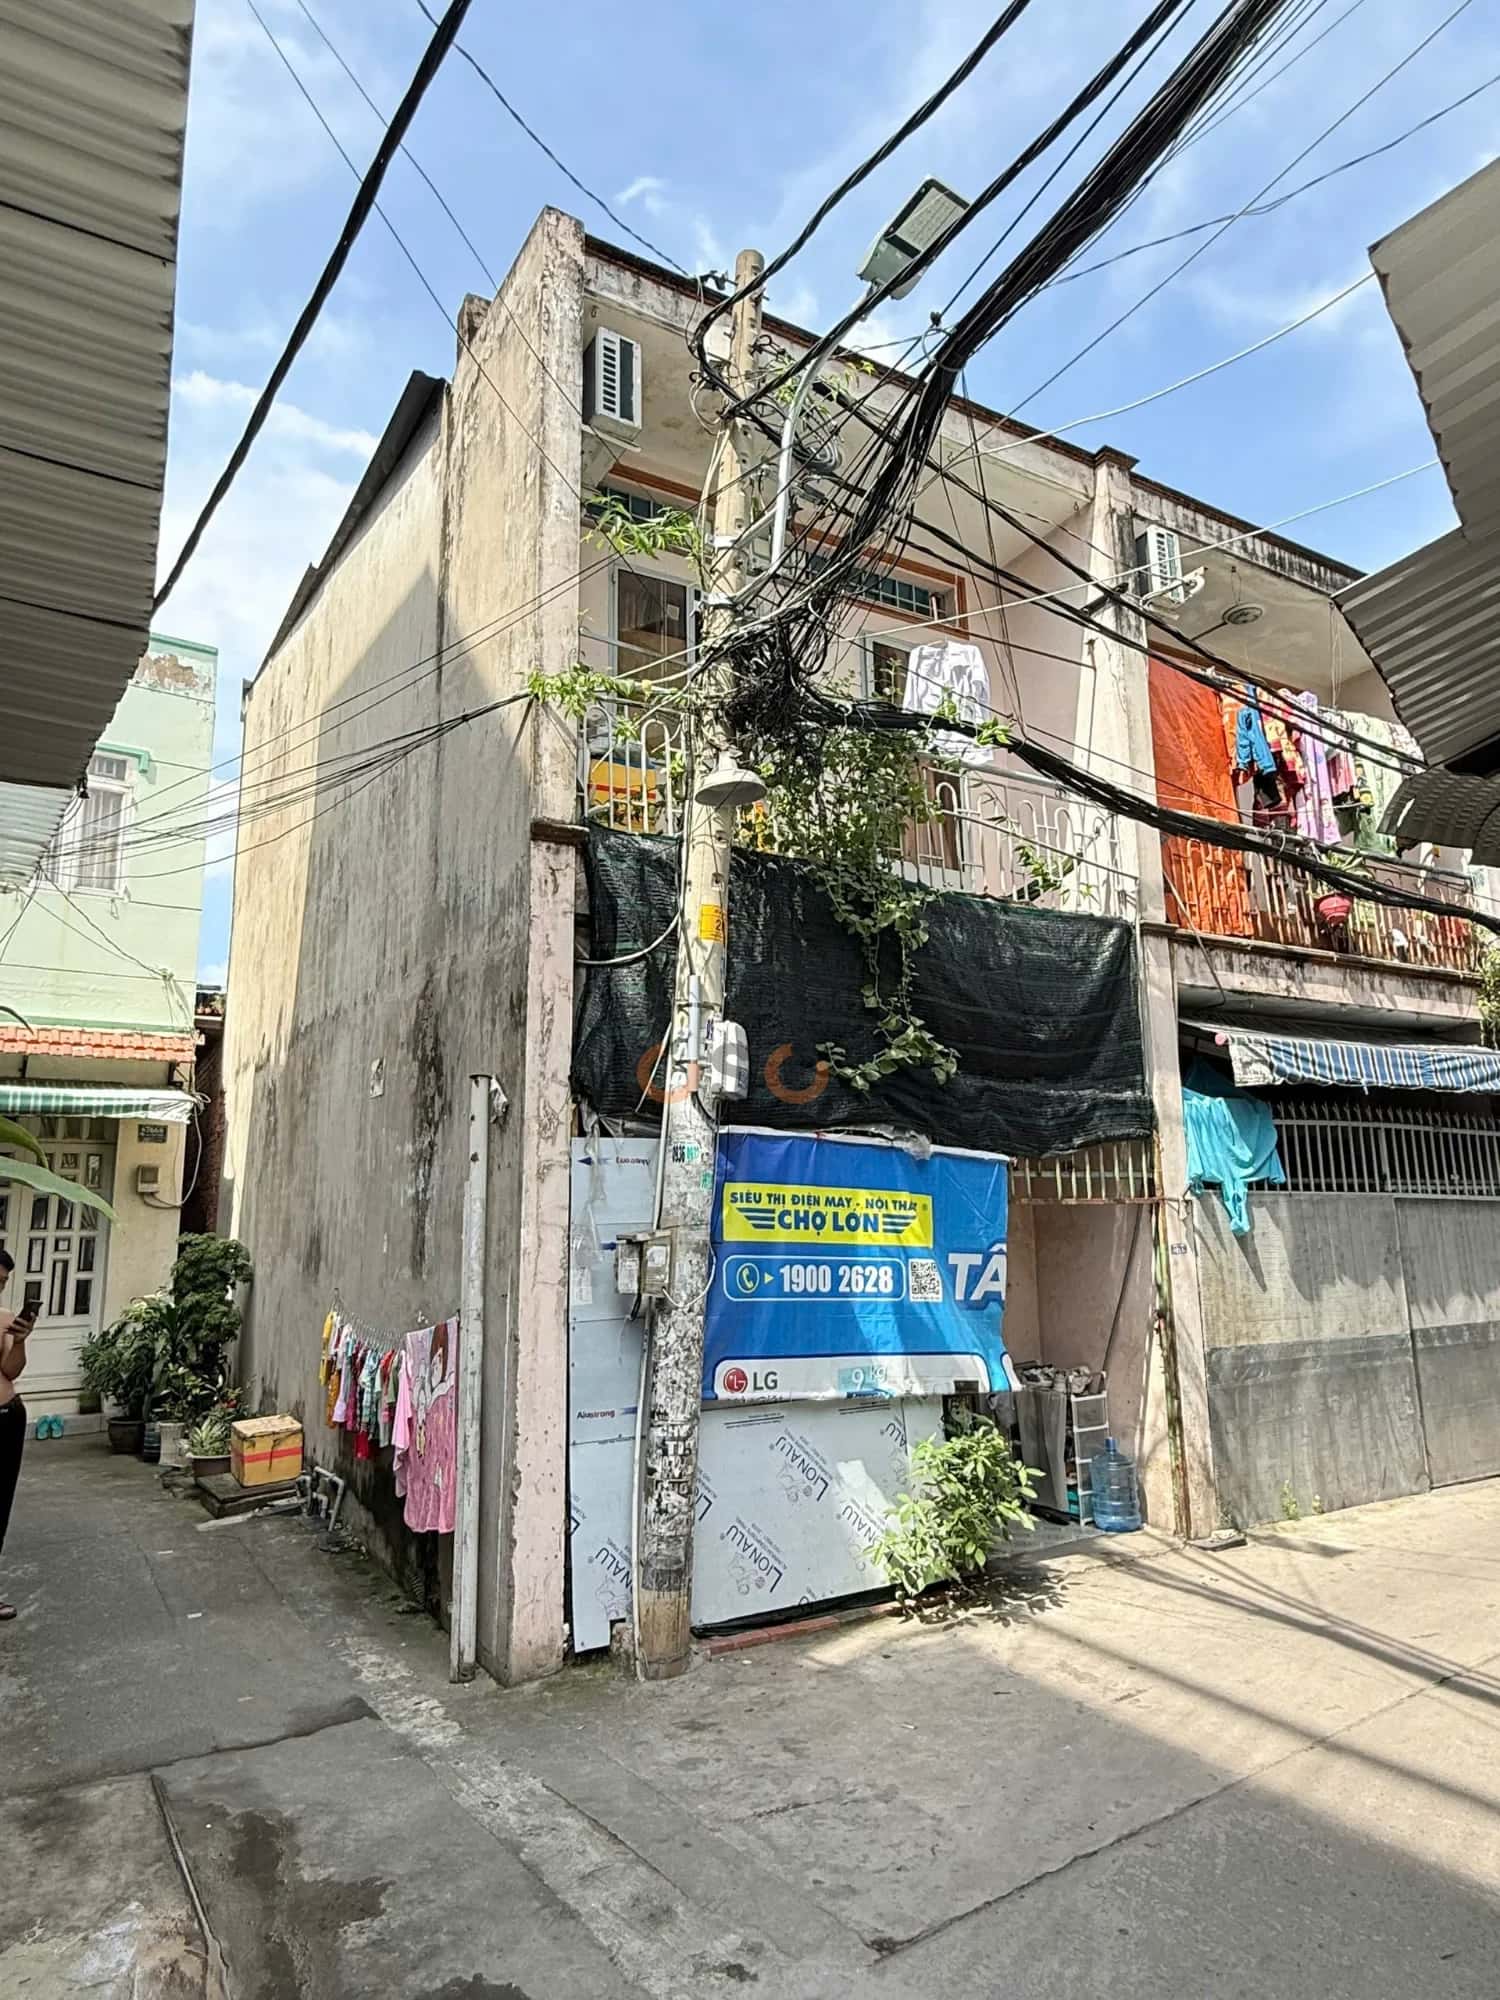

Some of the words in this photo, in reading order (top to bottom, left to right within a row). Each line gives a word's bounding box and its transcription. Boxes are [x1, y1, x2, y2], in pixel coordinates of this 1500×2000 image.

[777, 1208, 828, 1237] CHỢ
[779, 1263, 831, 1293] 1900
[838, 1264, 894, 1294] 2628
[753, 1371, 778, 1391] LG
[852, 1368, 865, 1392] 9
[775, 1436, 829, 1502] LIONALU
[726, 1524, 783, 1593] LIONALU
